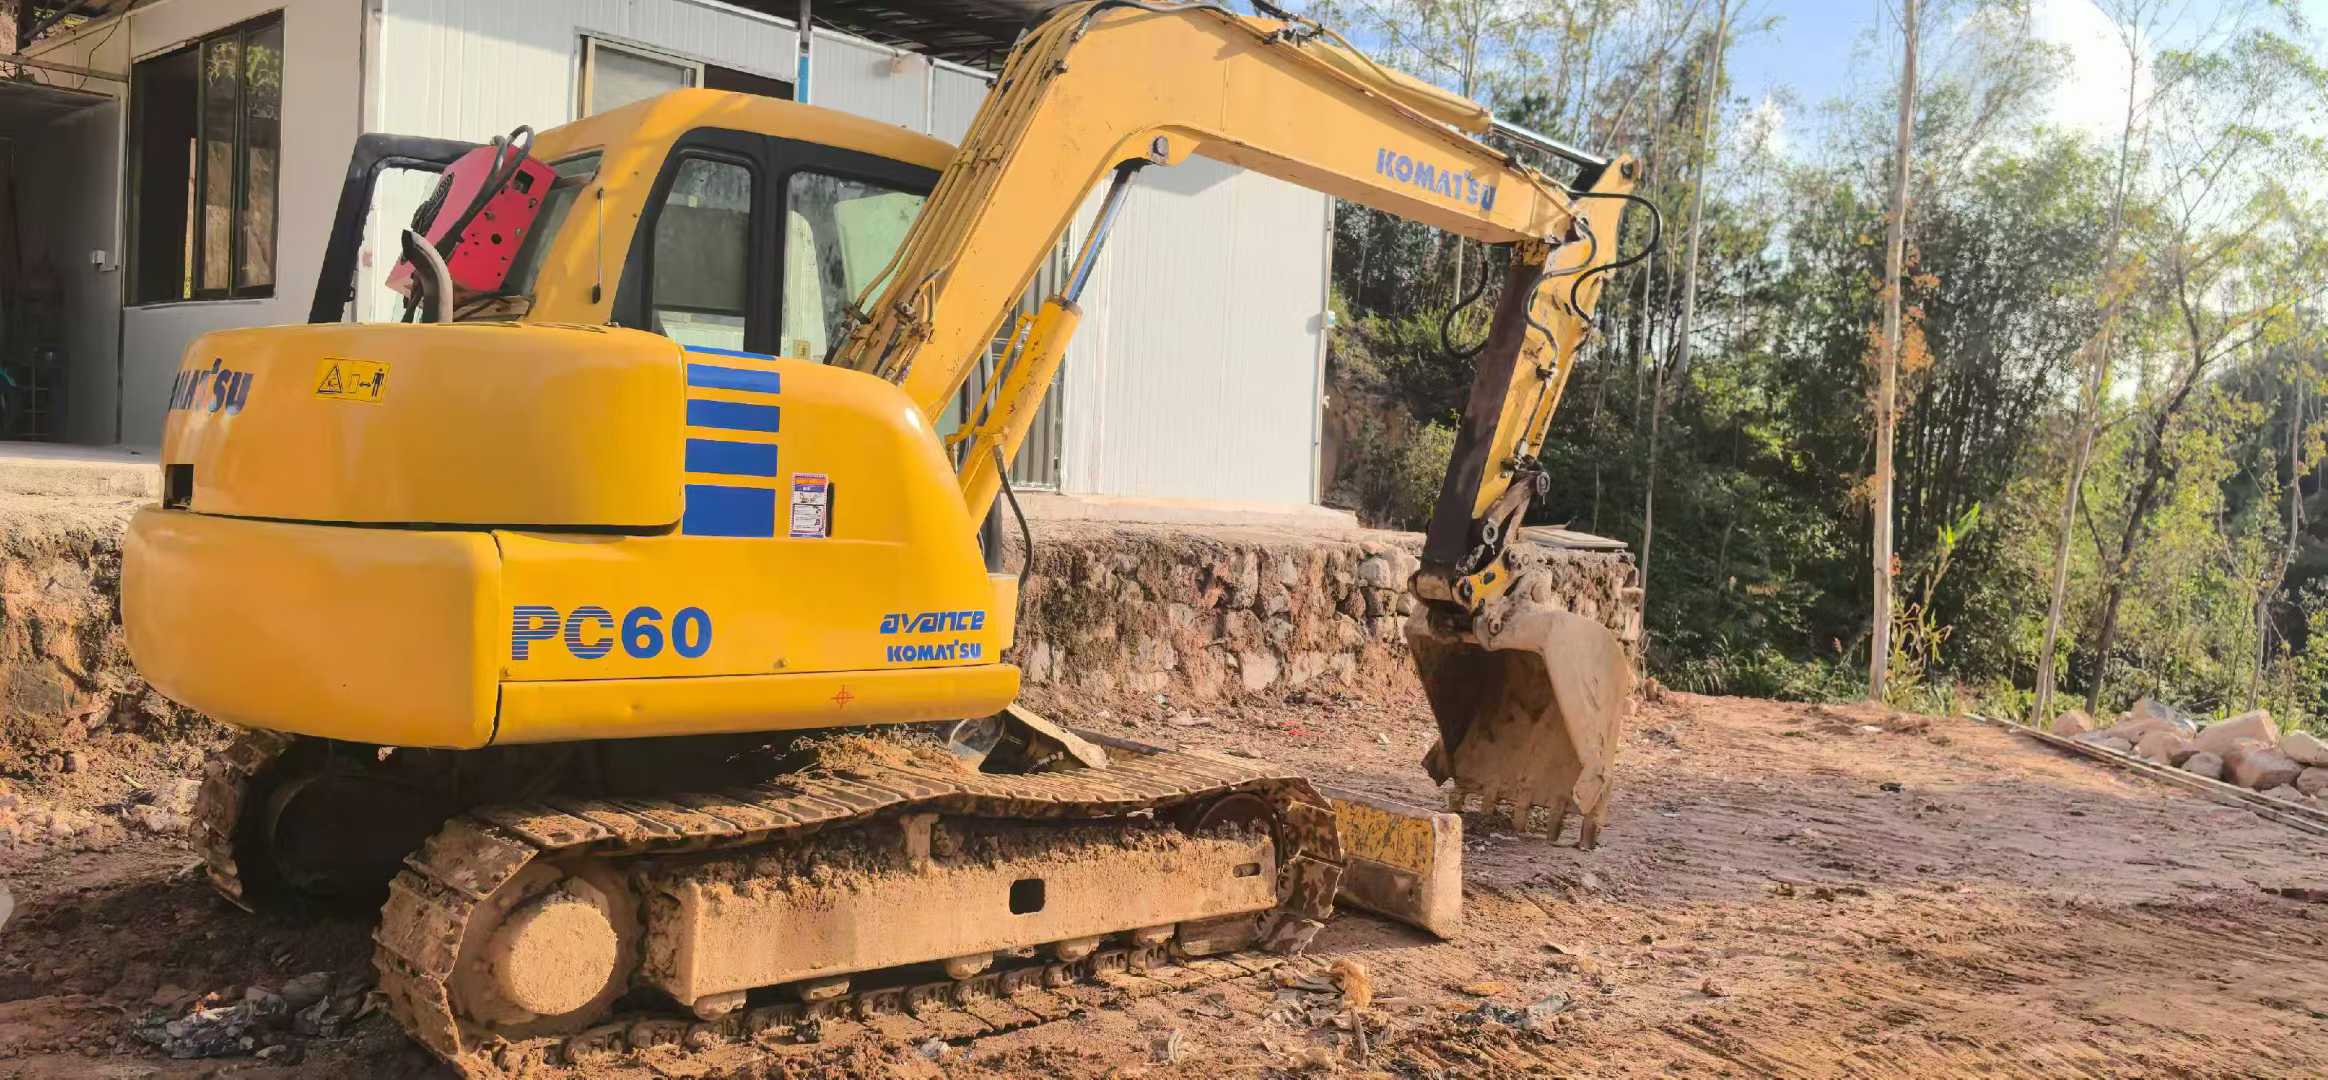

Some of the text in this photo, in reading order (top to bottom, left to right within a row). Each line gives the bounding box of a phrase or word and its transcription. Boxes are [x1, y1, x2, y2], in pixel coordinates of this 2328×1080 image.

[1376, 148, 1497, 211] KOMATSU
[511, 605, 713, 661] PC60
[879, 610, 985, 634] avance
[886, 638, 982, 662] KOMATSU
